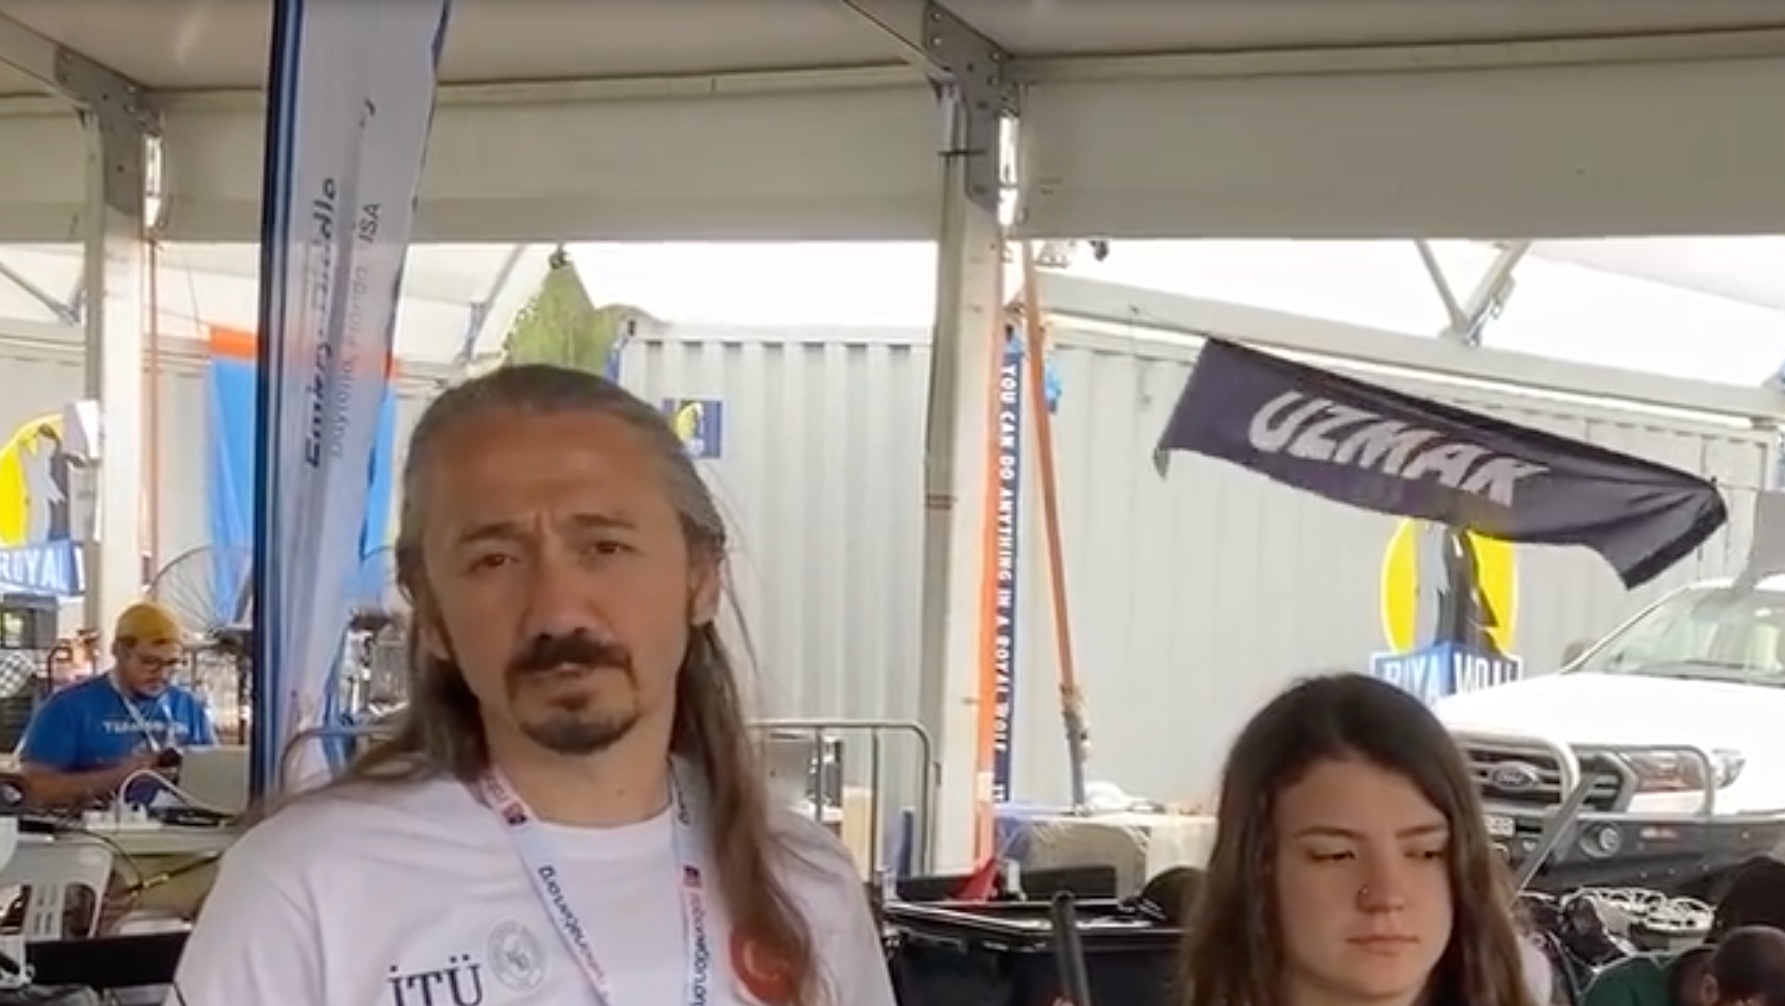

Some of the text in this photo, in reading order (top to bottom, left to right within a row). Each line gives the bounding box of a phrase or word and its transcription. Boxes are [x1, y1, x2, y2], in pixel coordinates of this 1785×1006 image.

[1001, 364, 1018, 403] YOU
[1000, 411, 1016, 448] CAN
[999, 455, 1015, 480] DO
[1249, 391, 1550, 508] UZMAK
[997, 486, 1014, 581] ANYTHING
[997, 589, 1011, 608] IN
[995, 613, 1010, 627] A
